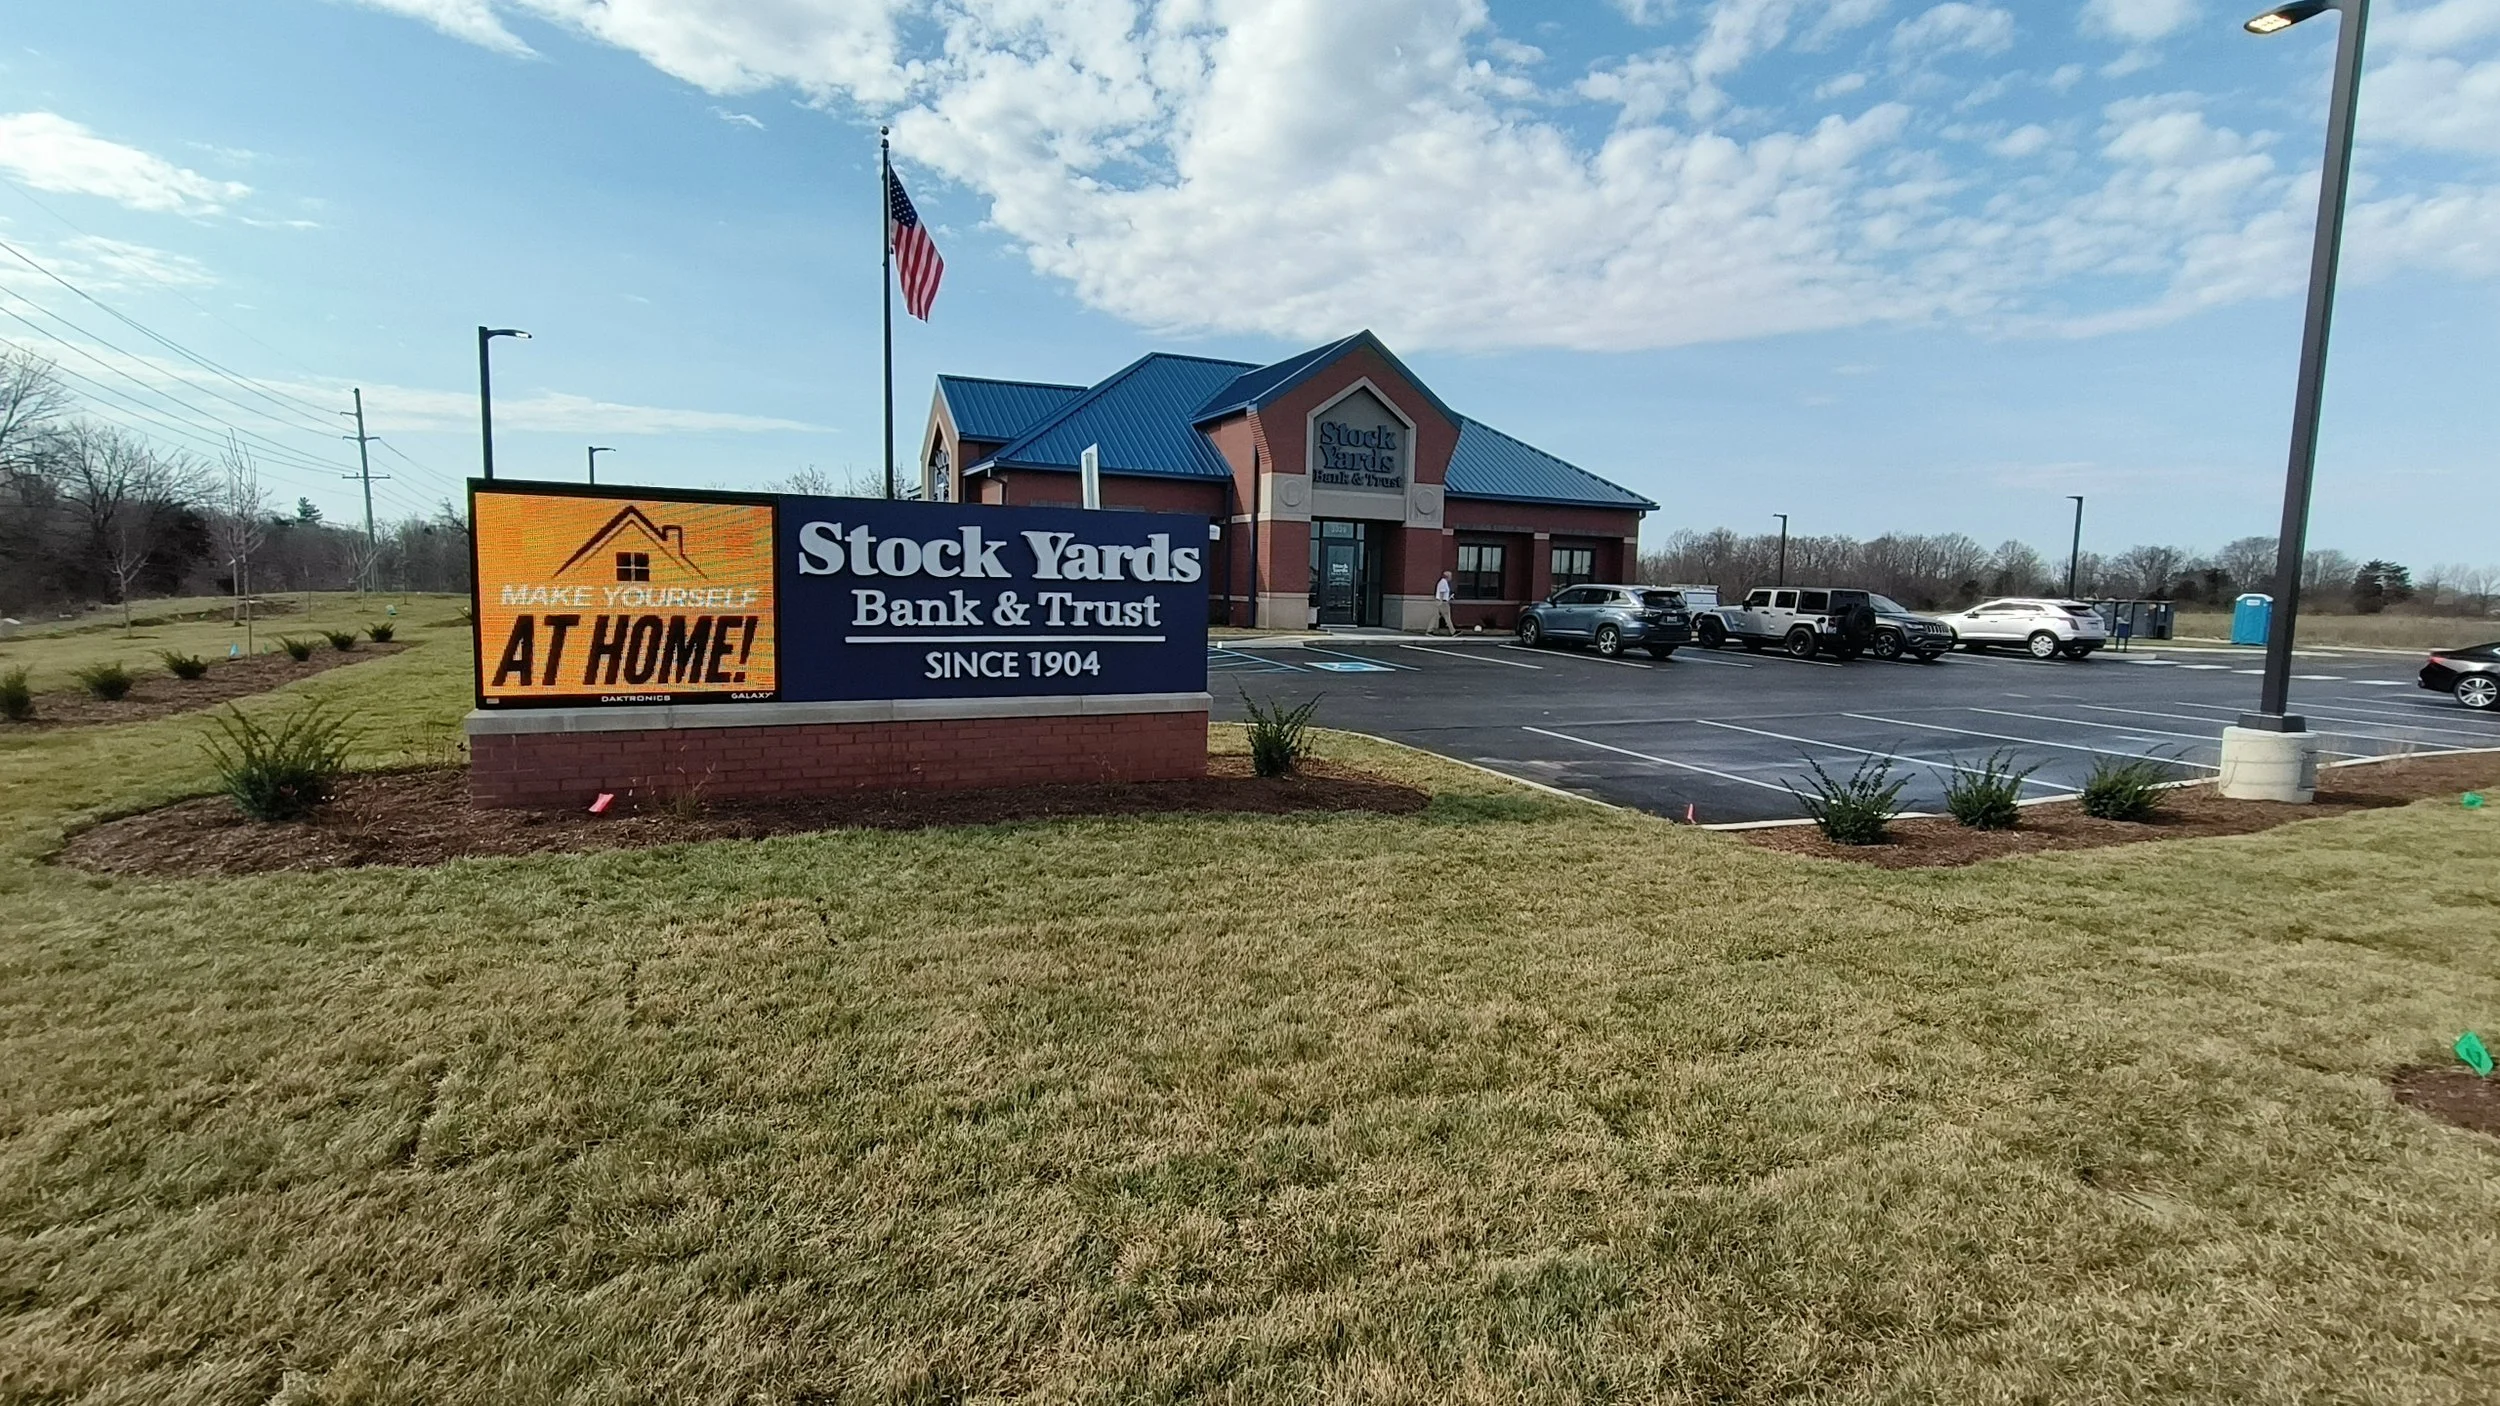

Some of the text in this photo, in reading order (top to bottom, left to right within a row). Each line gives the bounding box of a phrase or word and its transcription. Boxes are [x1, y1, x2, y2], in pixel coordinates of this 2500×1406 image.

[1320, 421, 1397, 450] Stock
[1319, 446, 1395, 474] Yards
[1312, 469, 1404, 488] Bank & Trust
[798, 521, 1202, 583] Stock Yards
[501, 584, 759, 609] MAKE YOURSELF
[850, 589, 1163, 628] Bank & Trust
[491, 613, 760, 687] AT HOME!
[923, 650, 1102, 680] SINCE 1904
[601, 691, 773, 703] DAKTRONICS GALAXY
